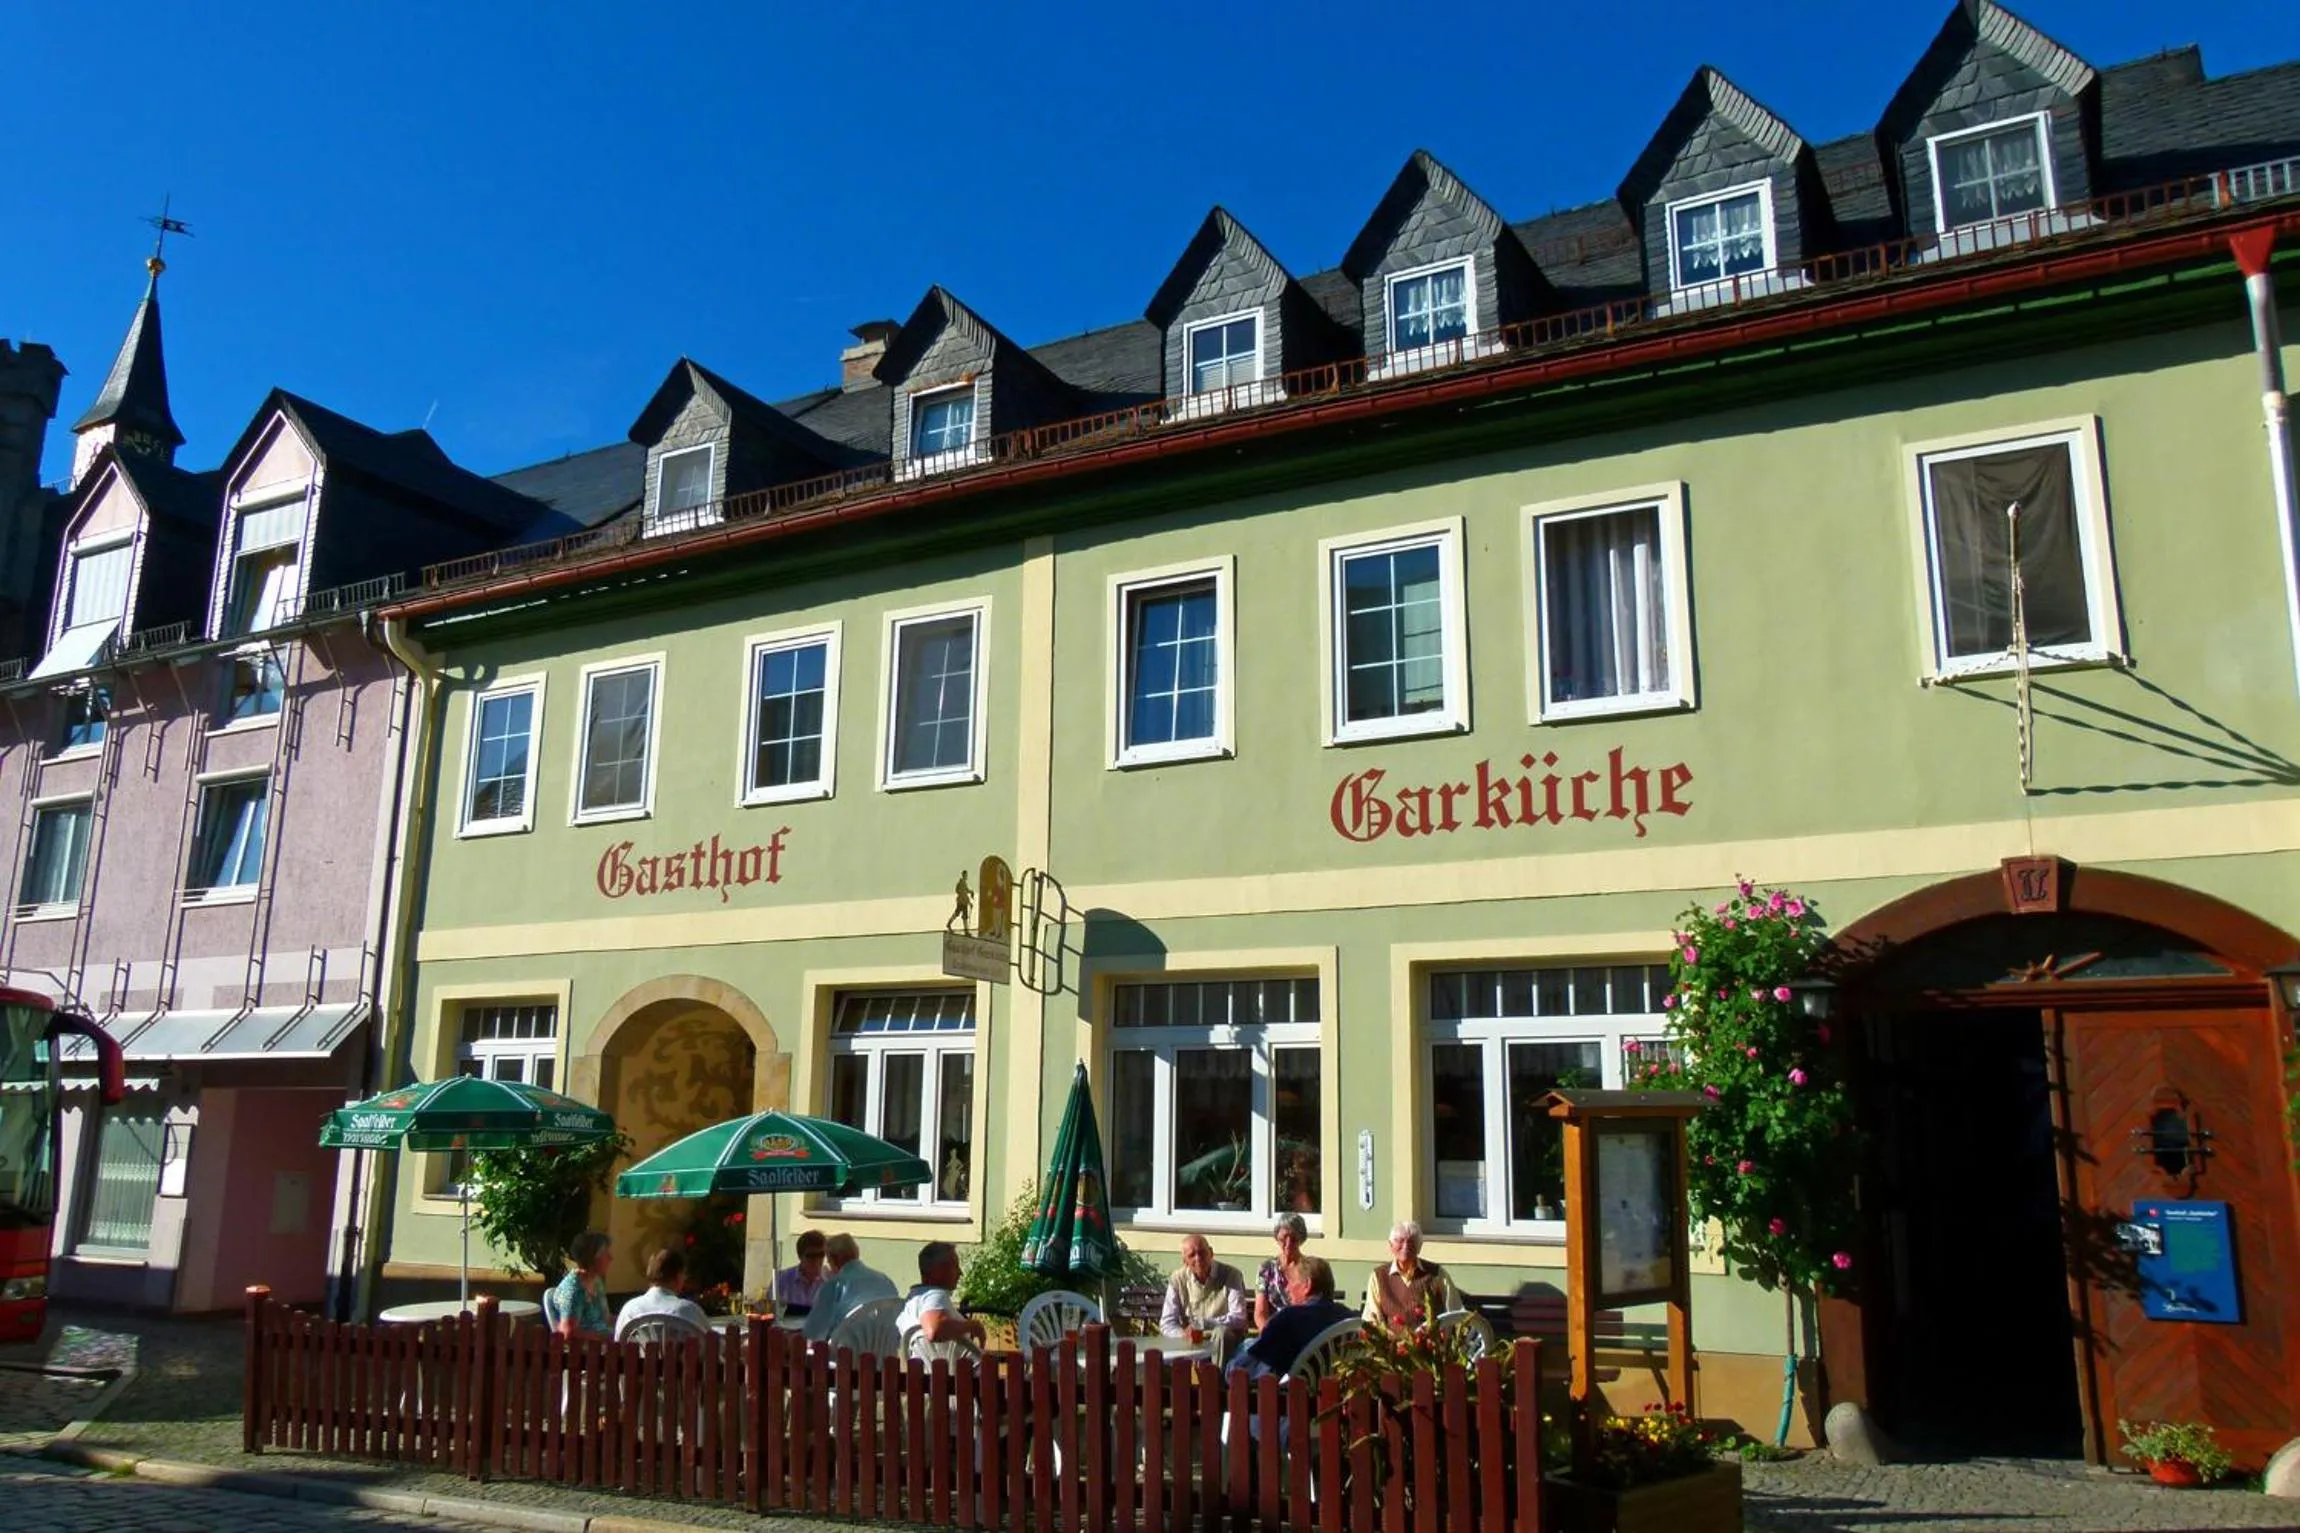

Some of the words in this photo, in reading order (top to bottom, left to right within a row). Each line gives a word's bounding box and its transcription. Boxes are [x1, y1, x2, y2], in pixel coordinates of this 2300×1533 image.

[1330, 745, 1694, 842] Garküche
[597, 825, 792, 903] Gasthof
[747, 1167, 820, 1186] Saalfelder
